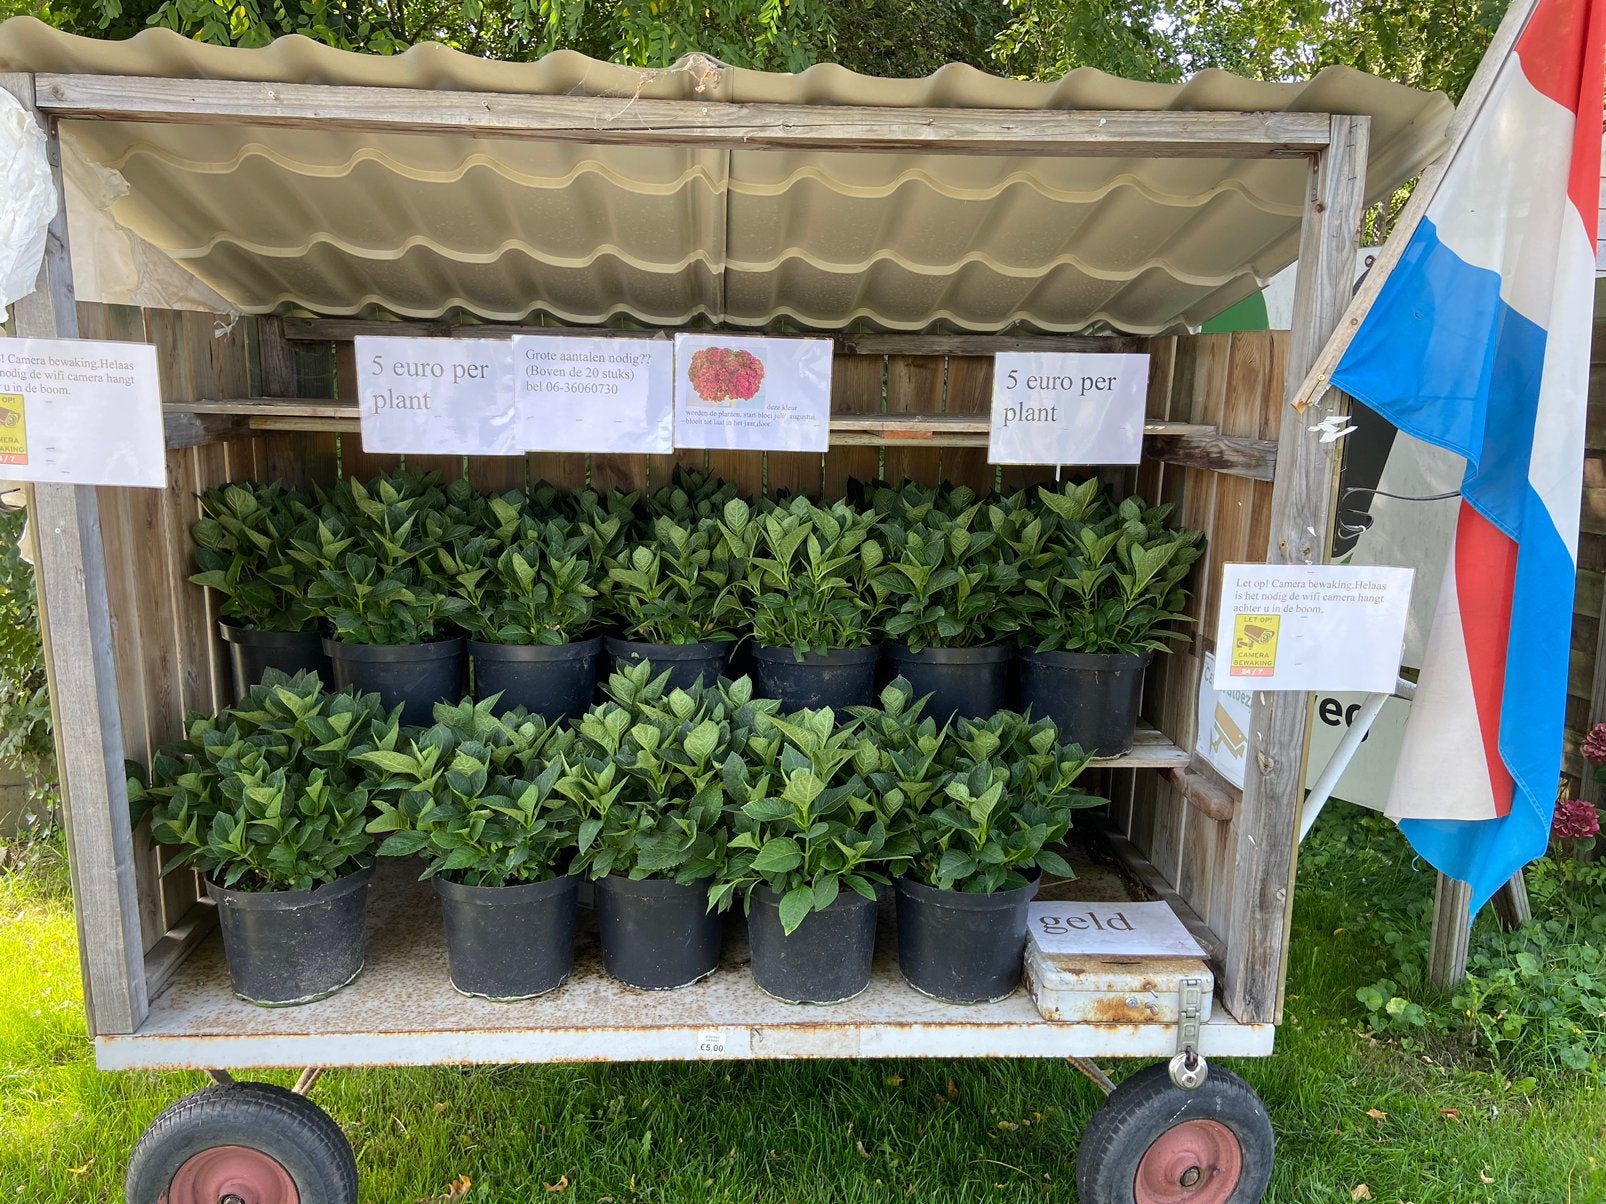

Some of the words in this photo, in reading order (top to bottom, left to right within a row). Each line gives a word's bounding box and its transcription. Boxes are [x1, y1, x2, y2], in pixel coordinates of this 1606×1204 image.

[8, 354, 46, 365] Camera
[525, 349, 557, 361] Grote
[560, 352, 605, 363] aantalen
[608, 352, 651, 366] nodig??
[0, 368, 27, 380] nodig
[30, 370, 41, 379] de
[44, 371, 64, 381] wifi
[67, 374, 103, 383] camera
[106, 374, 135, 386] hangt
[372, 355, 383, 376] 5
[393, 360, 444, 378] euro
[452, 363, 489, 384] per
[525, 365, 565, 378] (Boven
[569, 366, 582, 378] de
[585, 367, 599, 378] 20
[602, 368, 635, 381] stuks)
[13, 382, 22, 392] in
[25, 383, 37, 393] de
[40, 384, 71, 395] boom.
[526, 380, 543, 392] bel
[546, 381, 618, 395] 06-36060730
[1006, 370, 1018, 390] 5
[1026, 375, 1073, 391] euro
[1079, 375, 1117, 396] per
[372, 388, 431, 414] plant
[1003, 401, 1058, 427] plant
[1236, 578, 1251, 588] Let
[1254, 579, 1269, 591] op!
[1271, 579, 1306, 589] Camera
[1235, 591, 1243, 600] is
[1245, 591, 1259, 600] het
[1261, 591, 1287, 602] nodig
[1289, 591, 1300, 601] de
[1302, 592, 1320, 601] wifi
[1322, 594, 1355, 602] camera
[1357, 592, 1384, 604] hangt
[1233, 603, 1261, 613] achter
[1272, 604, 1281, 613] in
[1283, 604, 1294, 613] de
[1295, 604, 1324, 614] boom.
[1039, 911, 1136, 935] geld
